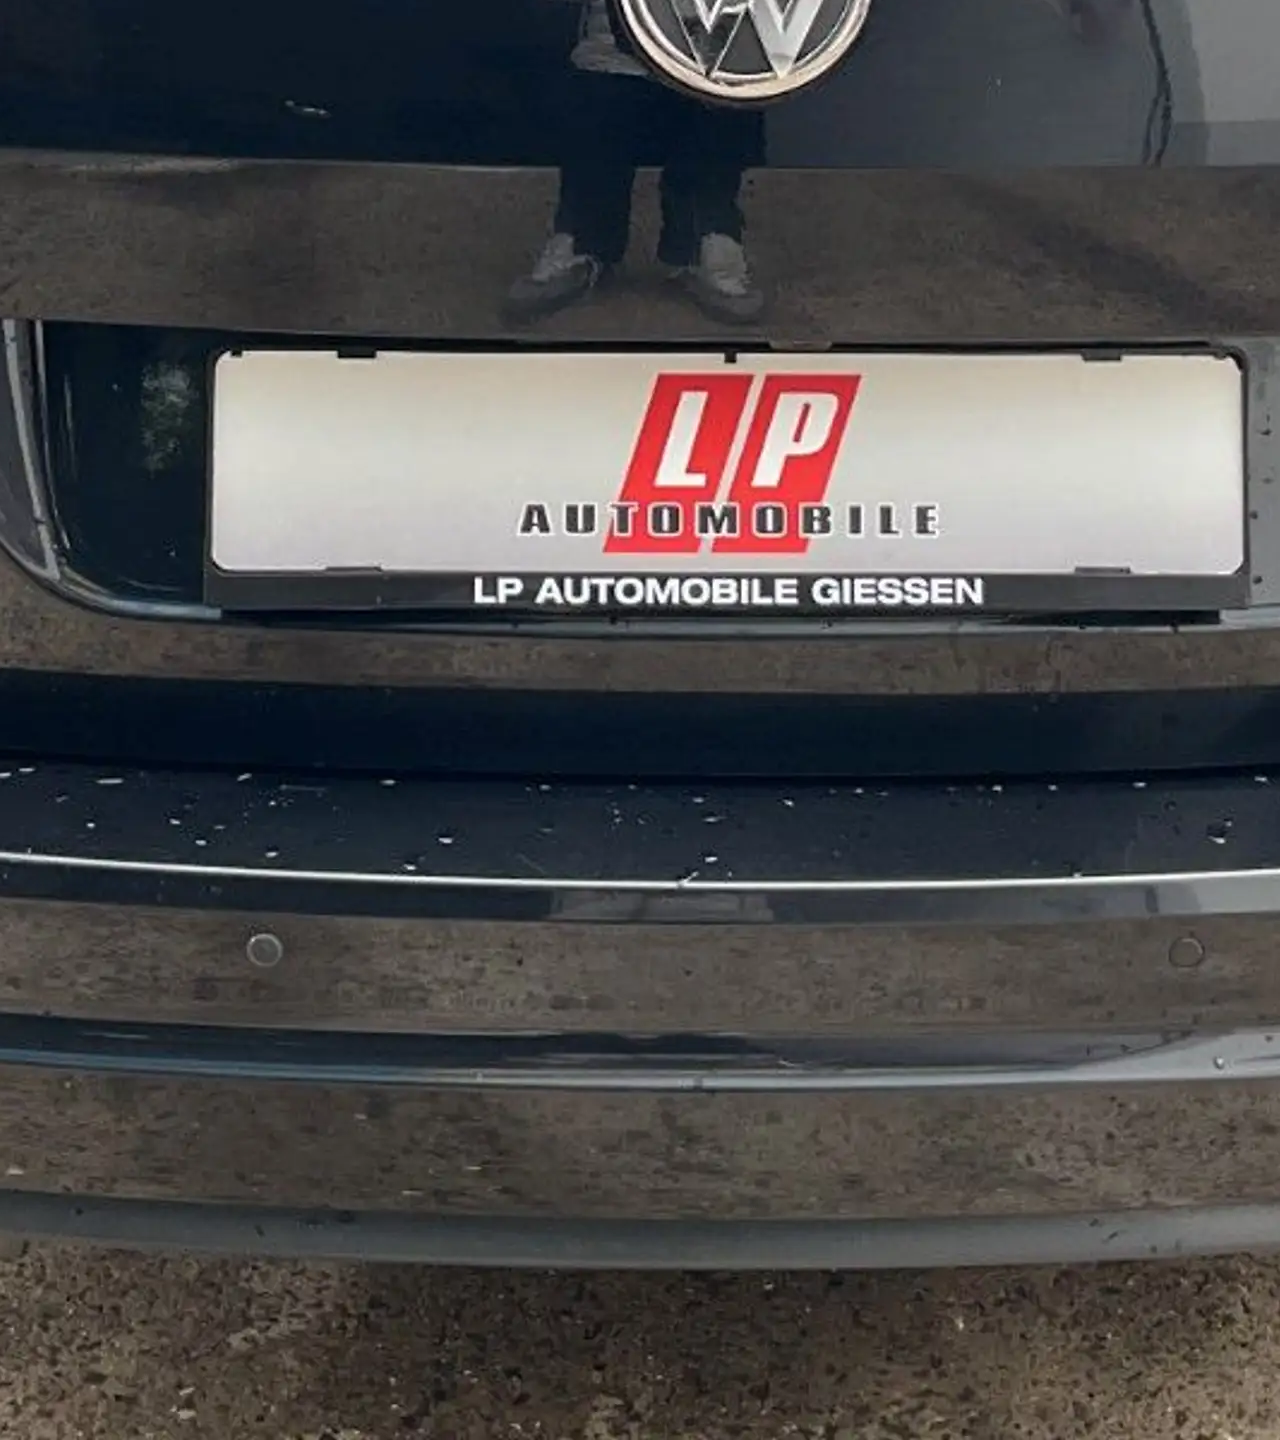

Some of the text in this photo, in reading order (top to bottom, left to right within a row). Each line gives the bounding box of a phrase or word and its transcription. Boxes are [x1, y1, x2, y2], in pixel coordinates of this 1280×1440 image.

[653, 390, 841, 488] LP
[519, 502, 941, 537] AUTOMOBILE
[473, 576, 984, 606] LP AUTOMOBILE GIESSEN
